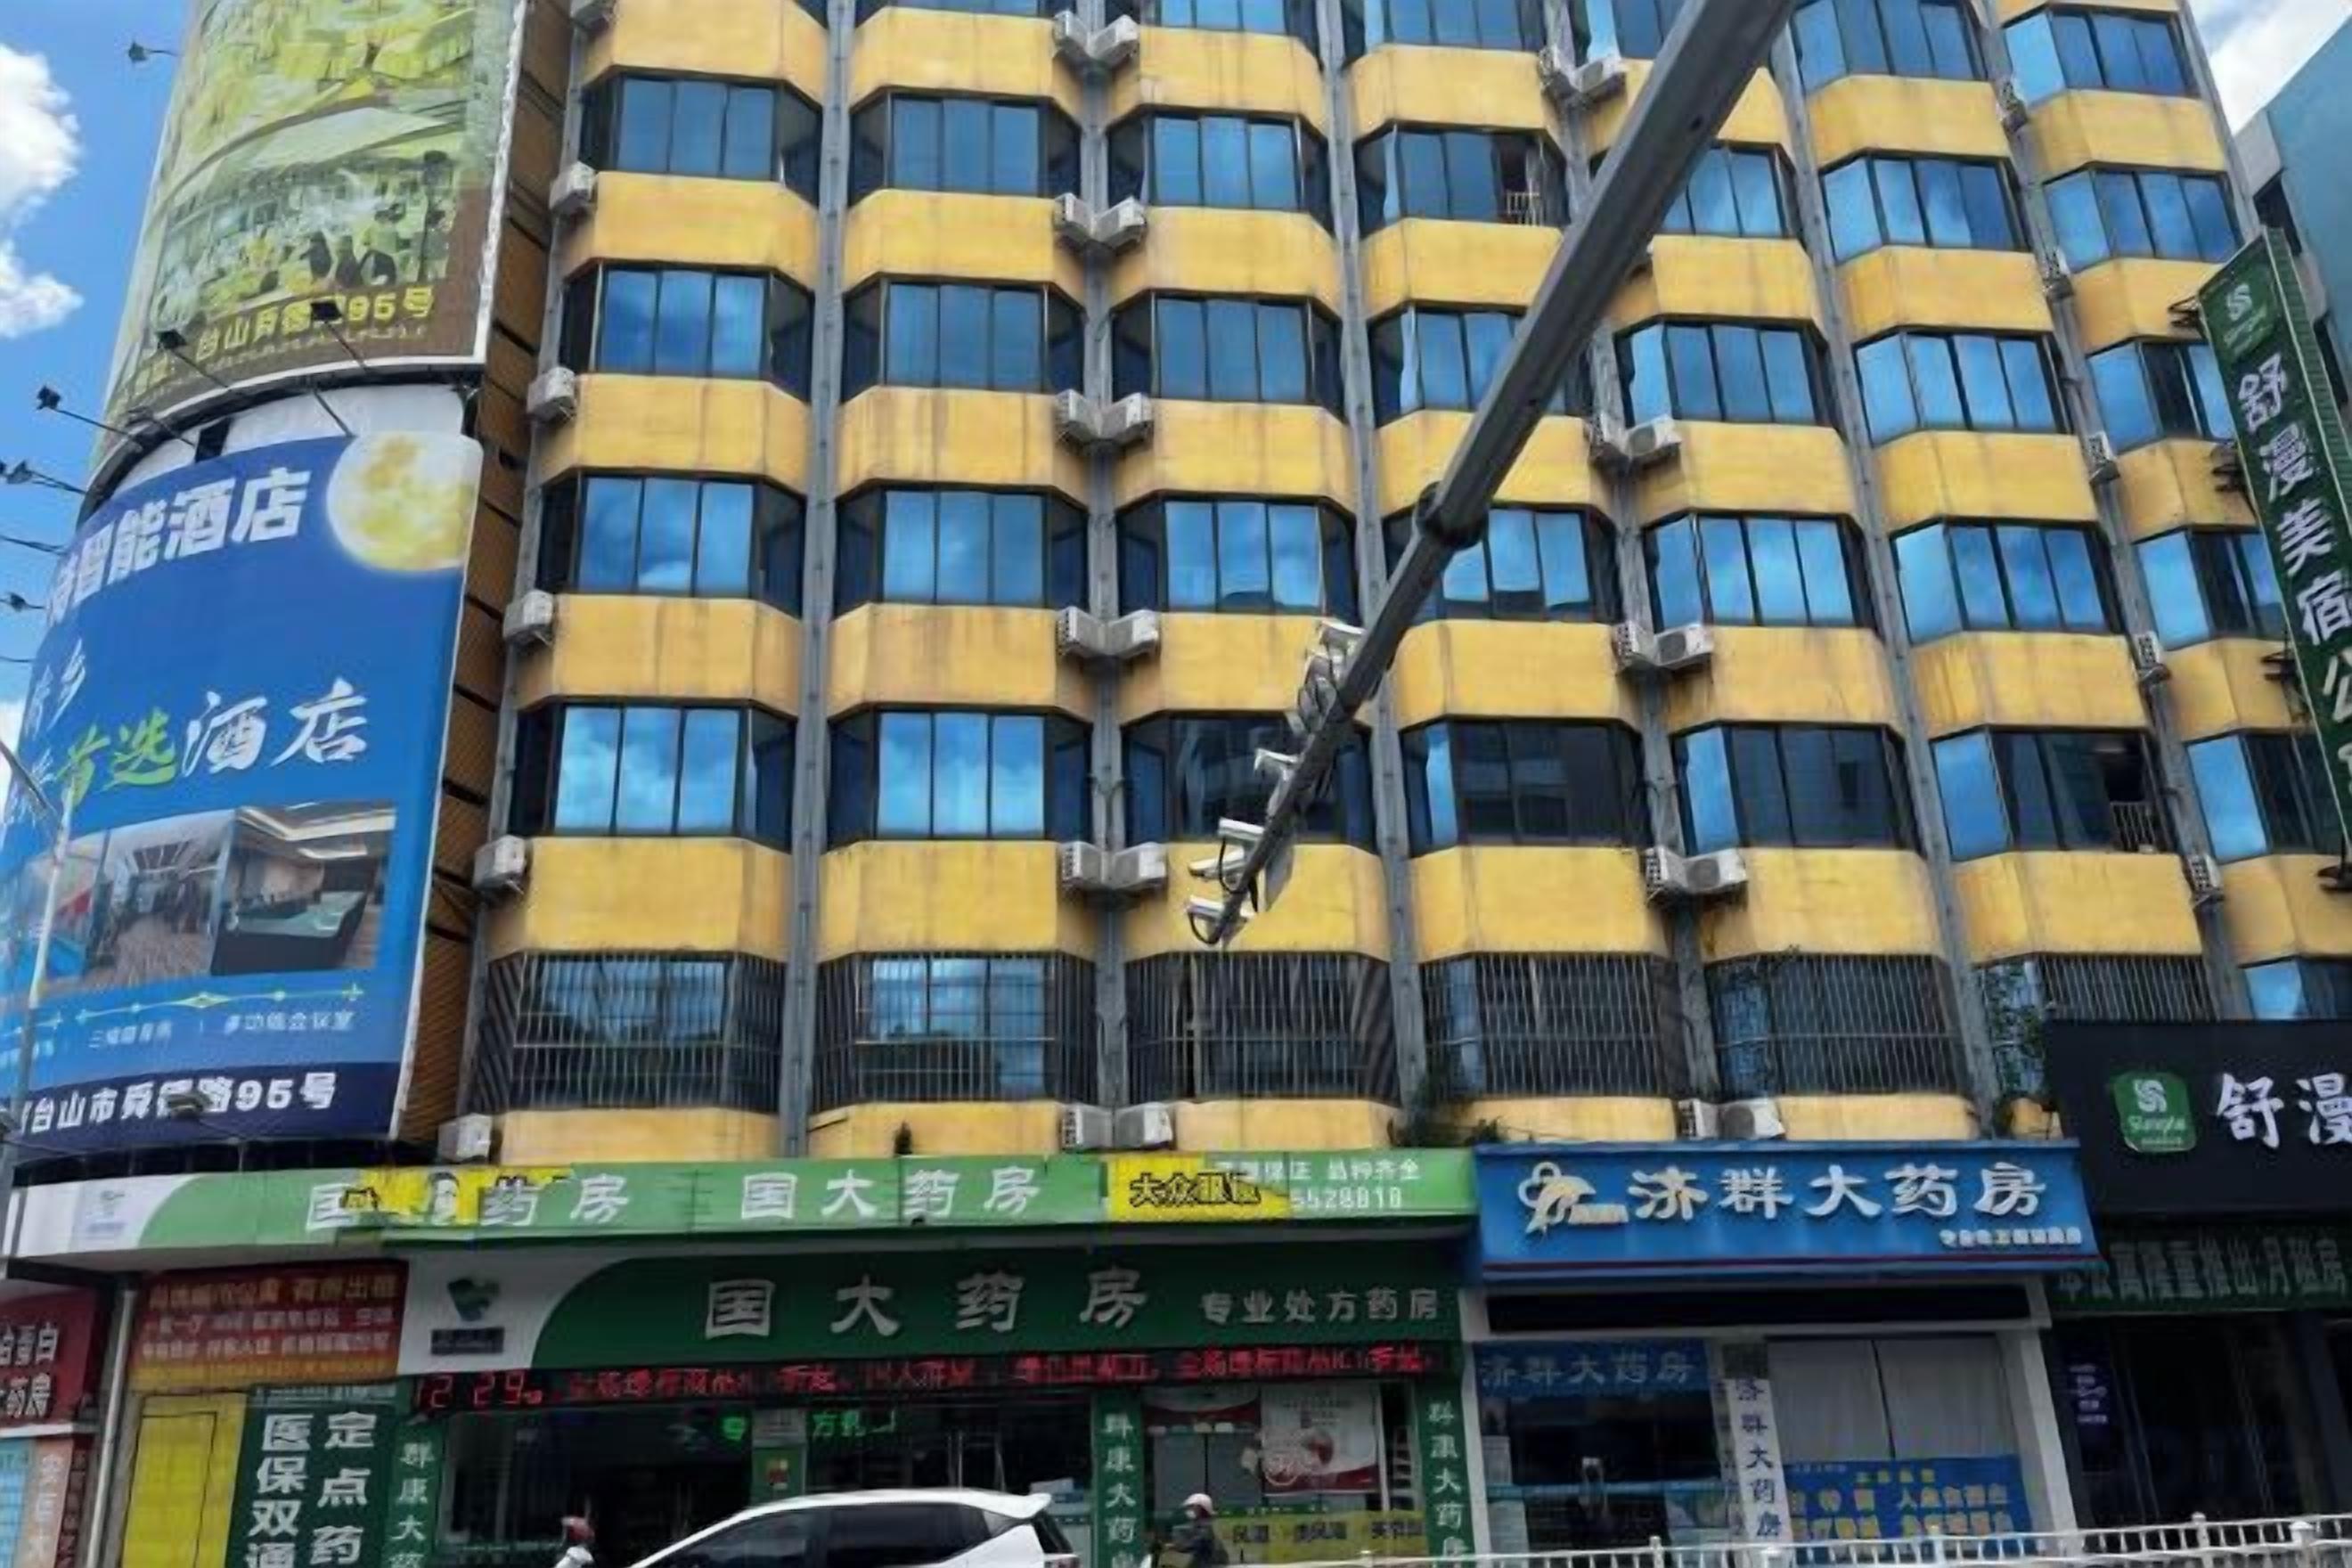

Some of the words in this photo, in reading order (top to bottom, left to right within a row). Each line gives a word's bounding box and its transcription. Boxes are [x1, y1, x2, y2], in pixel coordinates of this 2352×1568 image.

[2216, 1073, 2352, 1147] 舒漫
[307, 1173, 628, 1232] 国药房
[741, 1166, 1041, 1221] 国大药房
[1628, 1162, 2046, 1221] 济群大药房
[705, 1265, 1149, 1340] 国大药房
[1200, 1286, 1439, 1324] 专业处方药房
